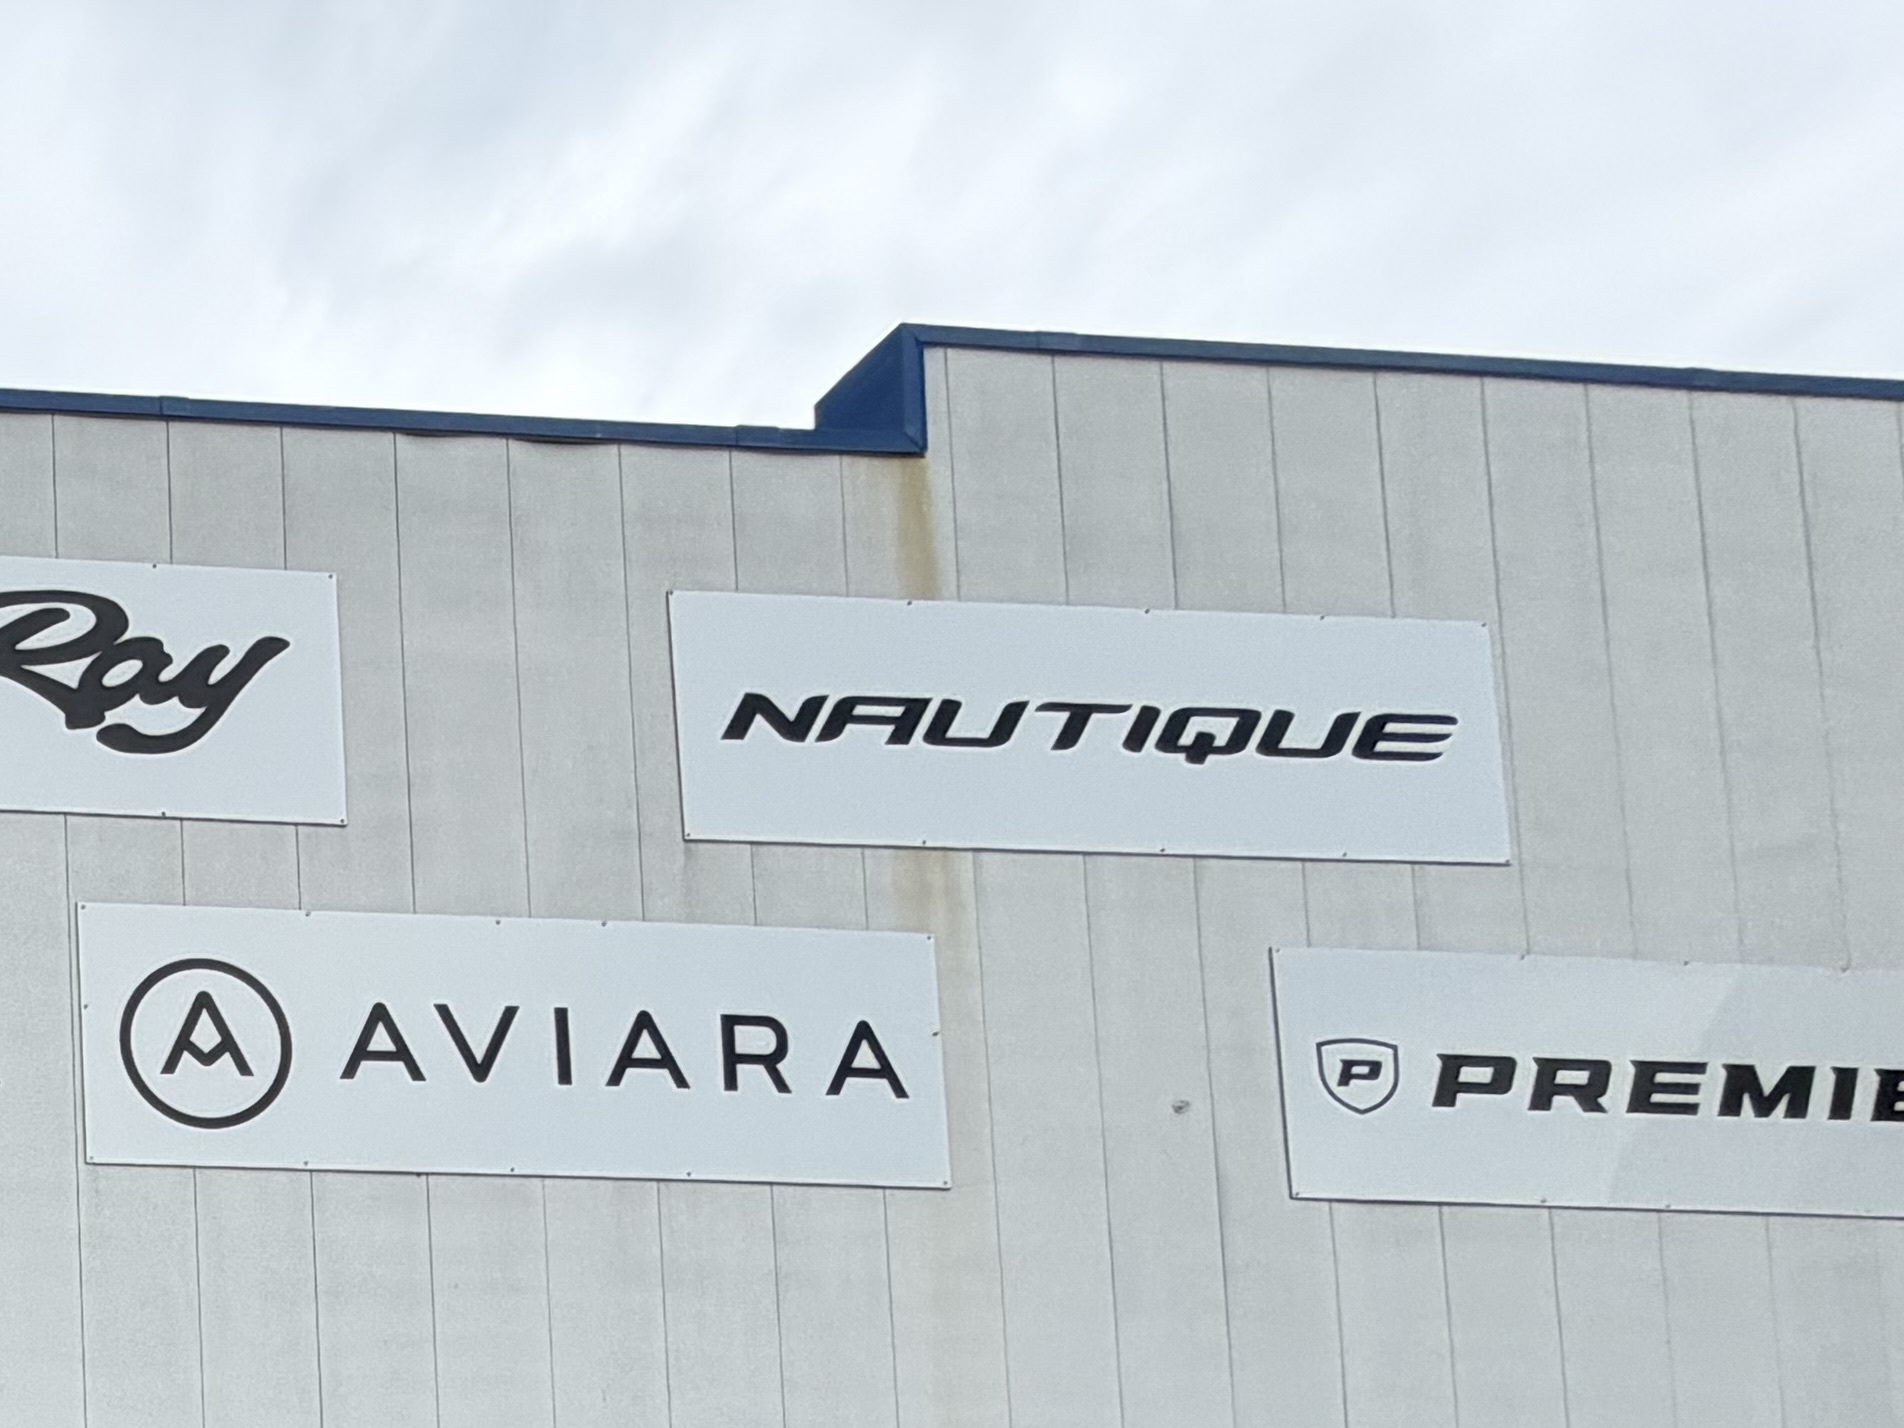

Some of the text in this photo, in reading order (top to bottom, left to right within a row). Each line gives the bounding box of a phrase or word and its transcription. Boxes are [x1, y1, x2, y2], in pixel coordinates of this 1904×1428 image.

[721, 692, 1458, 765] NAUTIQUE
[339, 1002, 909, 1099] AVIARA
[1337, 1059, 1383, 1087] P
